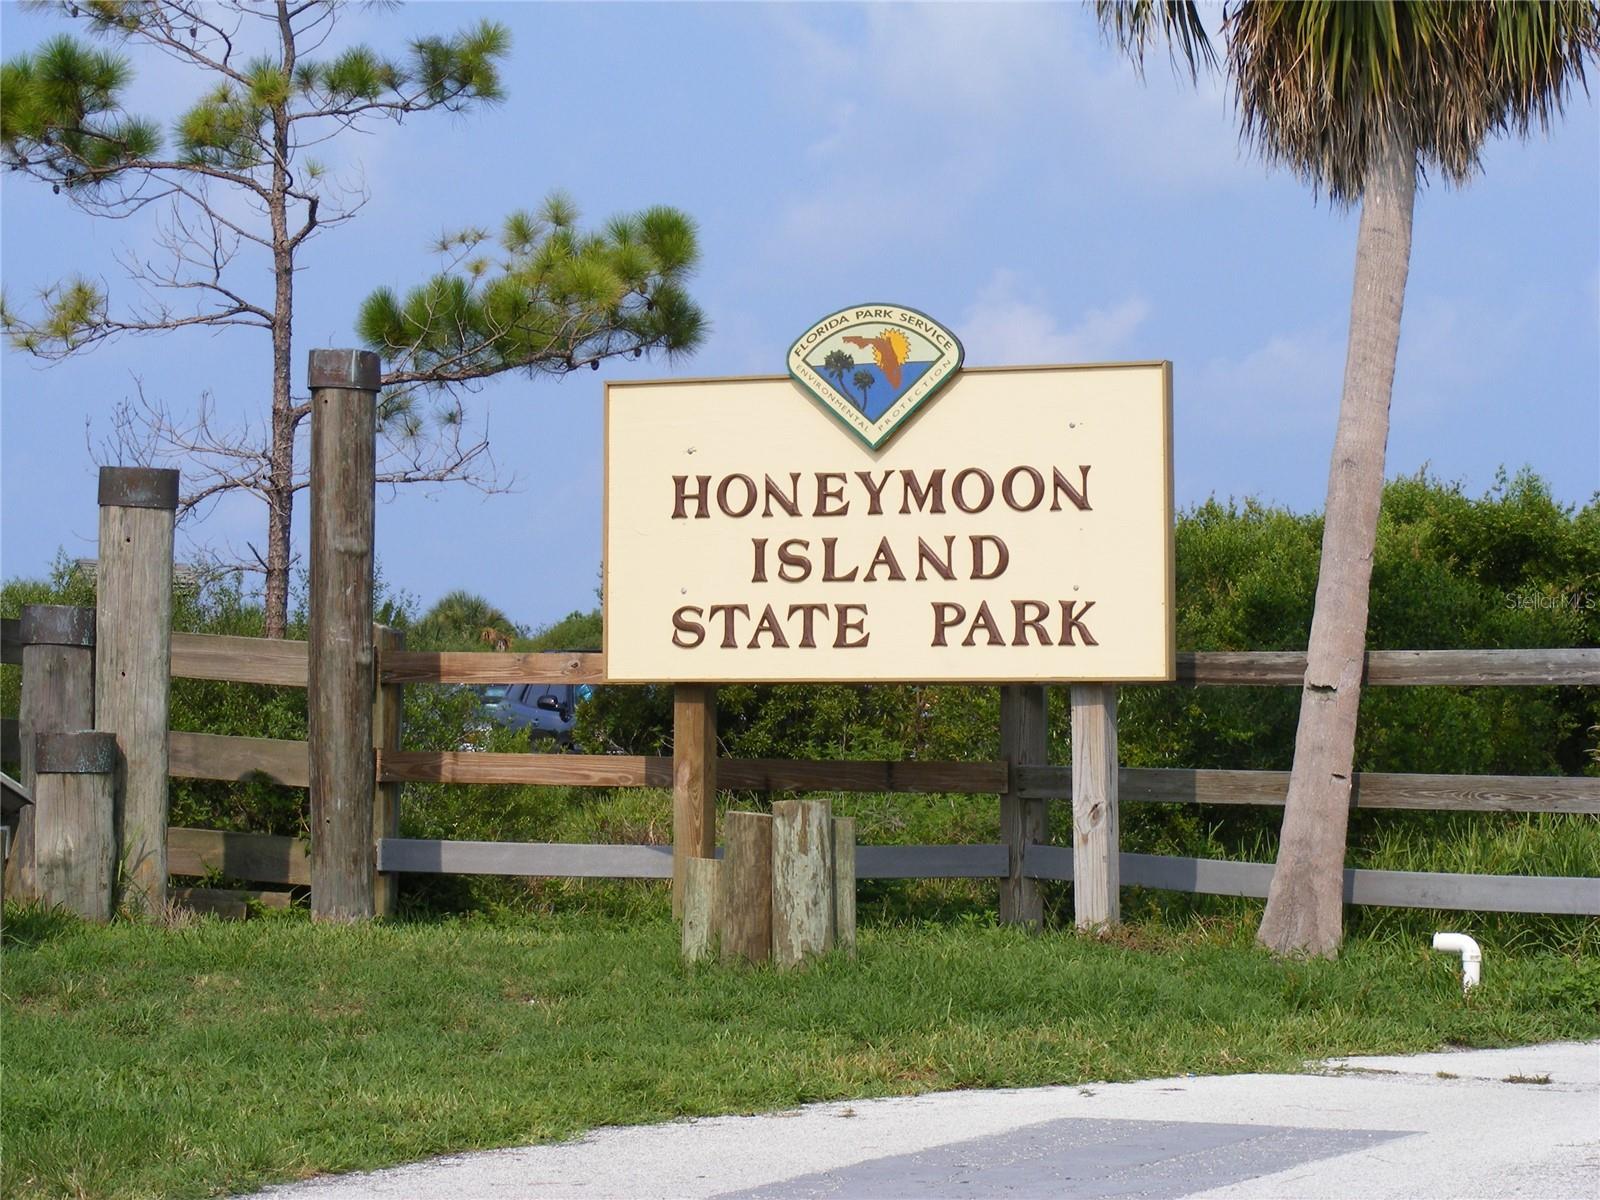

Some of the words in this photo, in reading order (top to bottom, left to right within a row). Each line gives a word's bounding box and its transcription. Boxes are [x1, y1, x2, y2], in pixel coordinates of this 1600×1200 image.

[795, 315, 850, 357] FLORIDA
[855, 309, 893, 320] PARK
[899, 312, 953, 350] SERVICE
[795, 364, 870, 432] ENVIRONMENTAL
[878, 360, 951, 431] PROTECTION
[671, 465, 1093, 519] HONEYMOON
[751, 535, 1010, 584] ISLAND
[671, 602, 871, 650] STATE
[930, 599, 1100, 648] PARK
